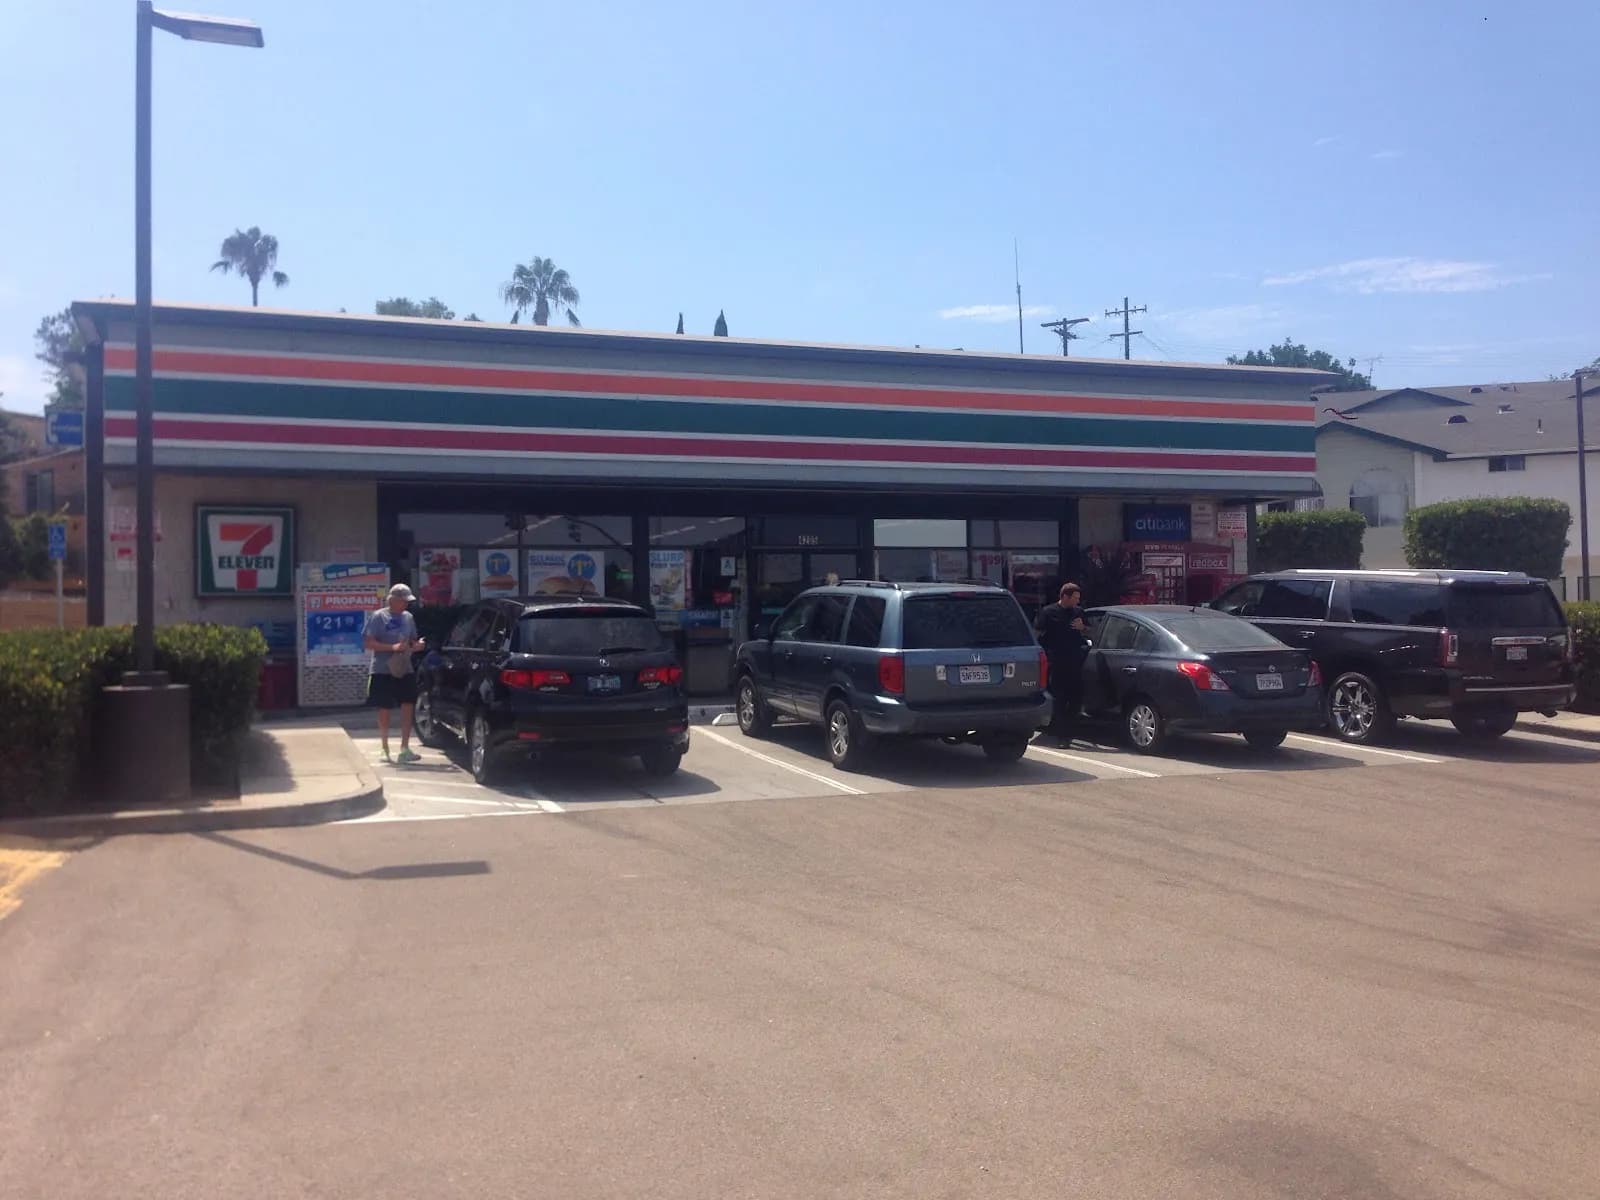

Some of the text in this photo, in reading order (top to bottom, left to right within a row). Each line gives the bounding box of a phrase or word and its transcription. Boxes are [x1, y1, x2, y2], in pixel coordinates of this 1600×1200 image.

[1136, 517, 1186, 530] citibank
[1192, 558, 1225, 568] redbox
[325, 596, 378, 605] PROPANE
